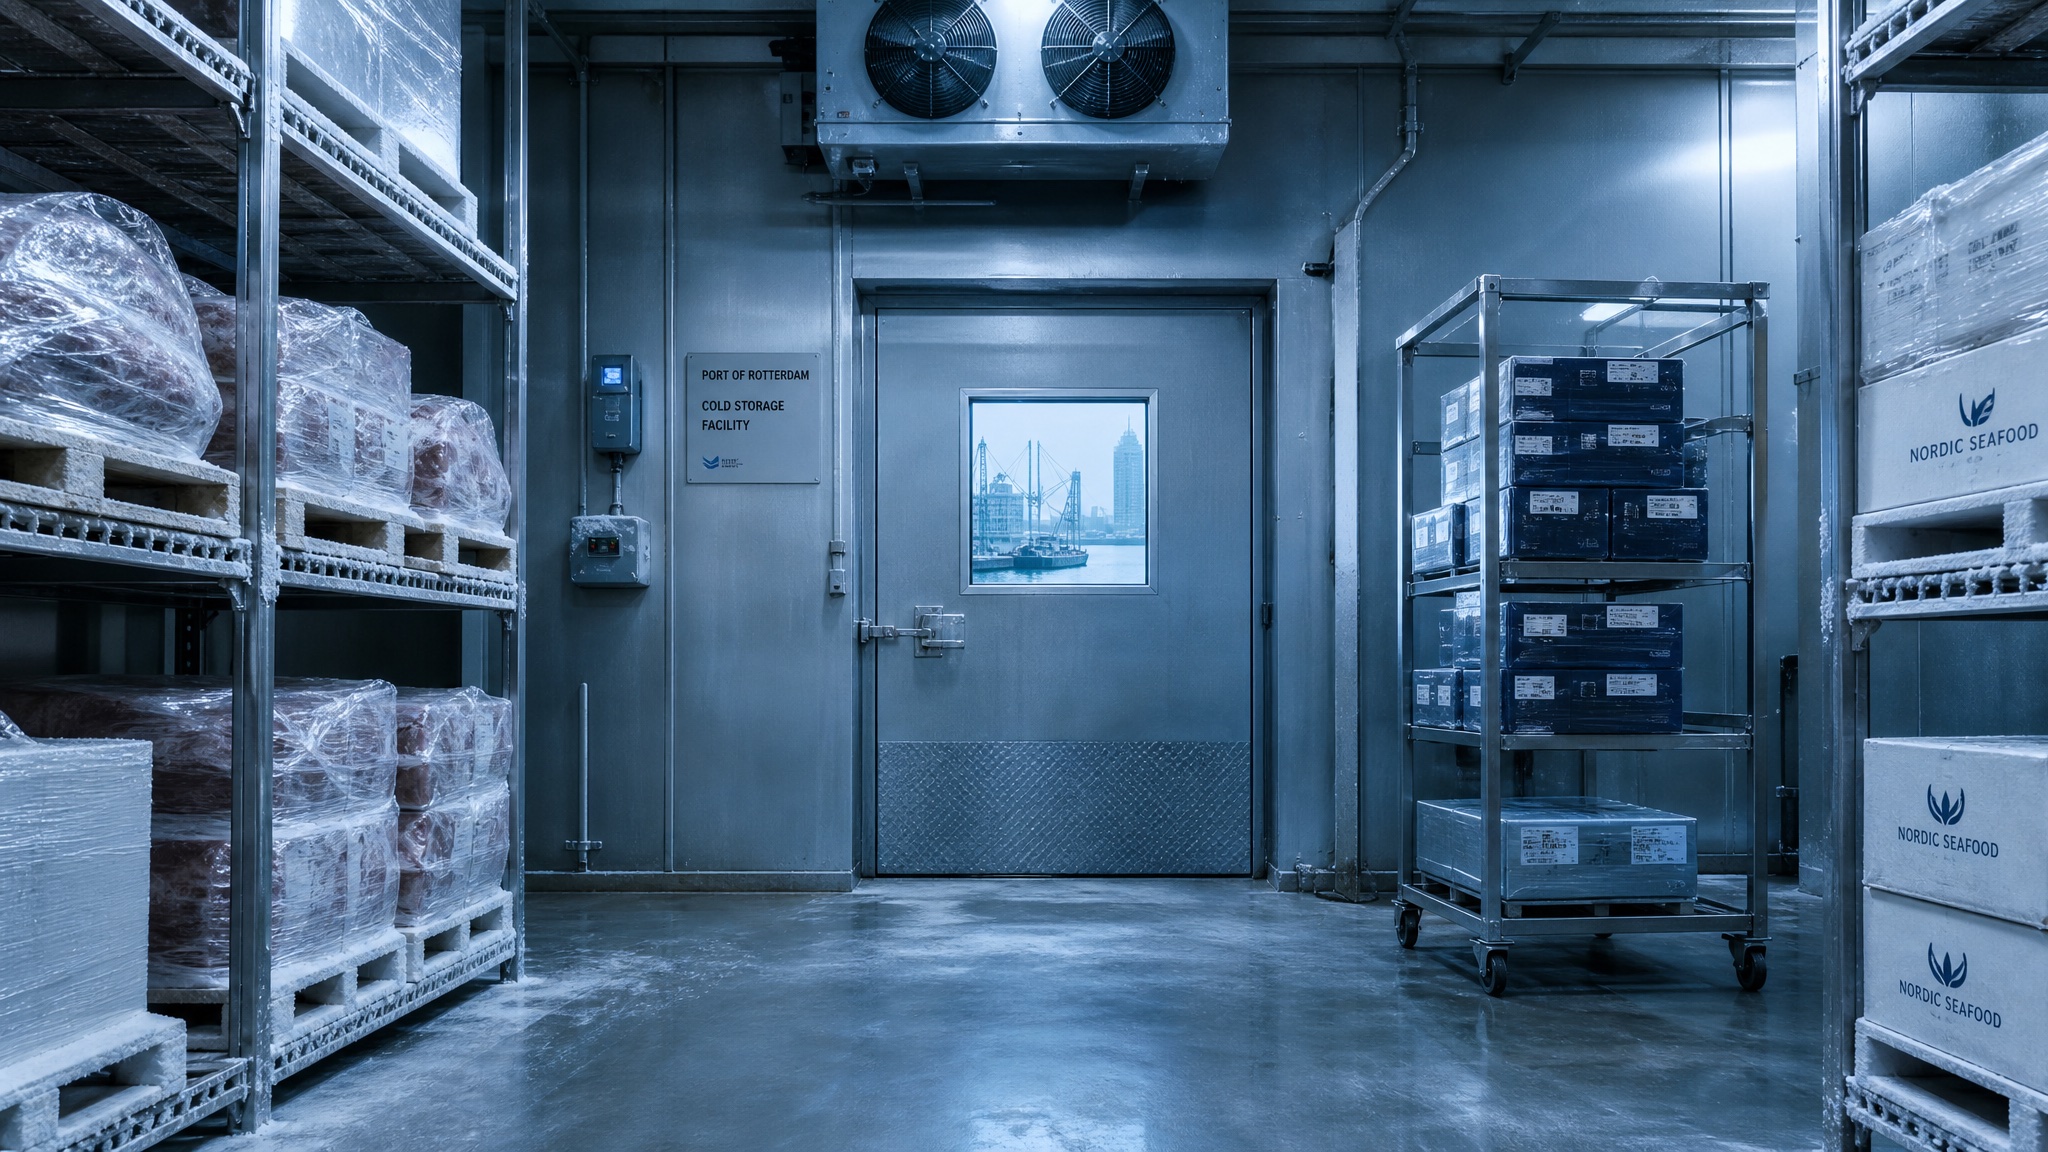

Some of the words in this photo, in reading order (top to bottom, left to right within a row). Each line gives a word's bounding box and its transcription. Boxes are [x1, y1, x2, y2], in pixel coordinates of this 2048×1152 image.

[702, 370, 730, 381] PORT
[732, 370, 746, 381] OF
[748, 370, 810, 381] ROTTERDAM
[702, 400, 731, 412] COLD
[735, 400, 785, 412] STORAGE
[702, 419, 750, 431] FACILITY
[1910, 438, 1964, 463] NORDIC
[1969, 423, 2039, 452] SEAFOOD
[1898, 826, 1940, 847] NORDIC
[1943, 834, 1999, 858] SEAFOOD
[1899, 979, 1942, 1007] NORDIC
[1945, 996, 2002, 1029] SEAFOOD
